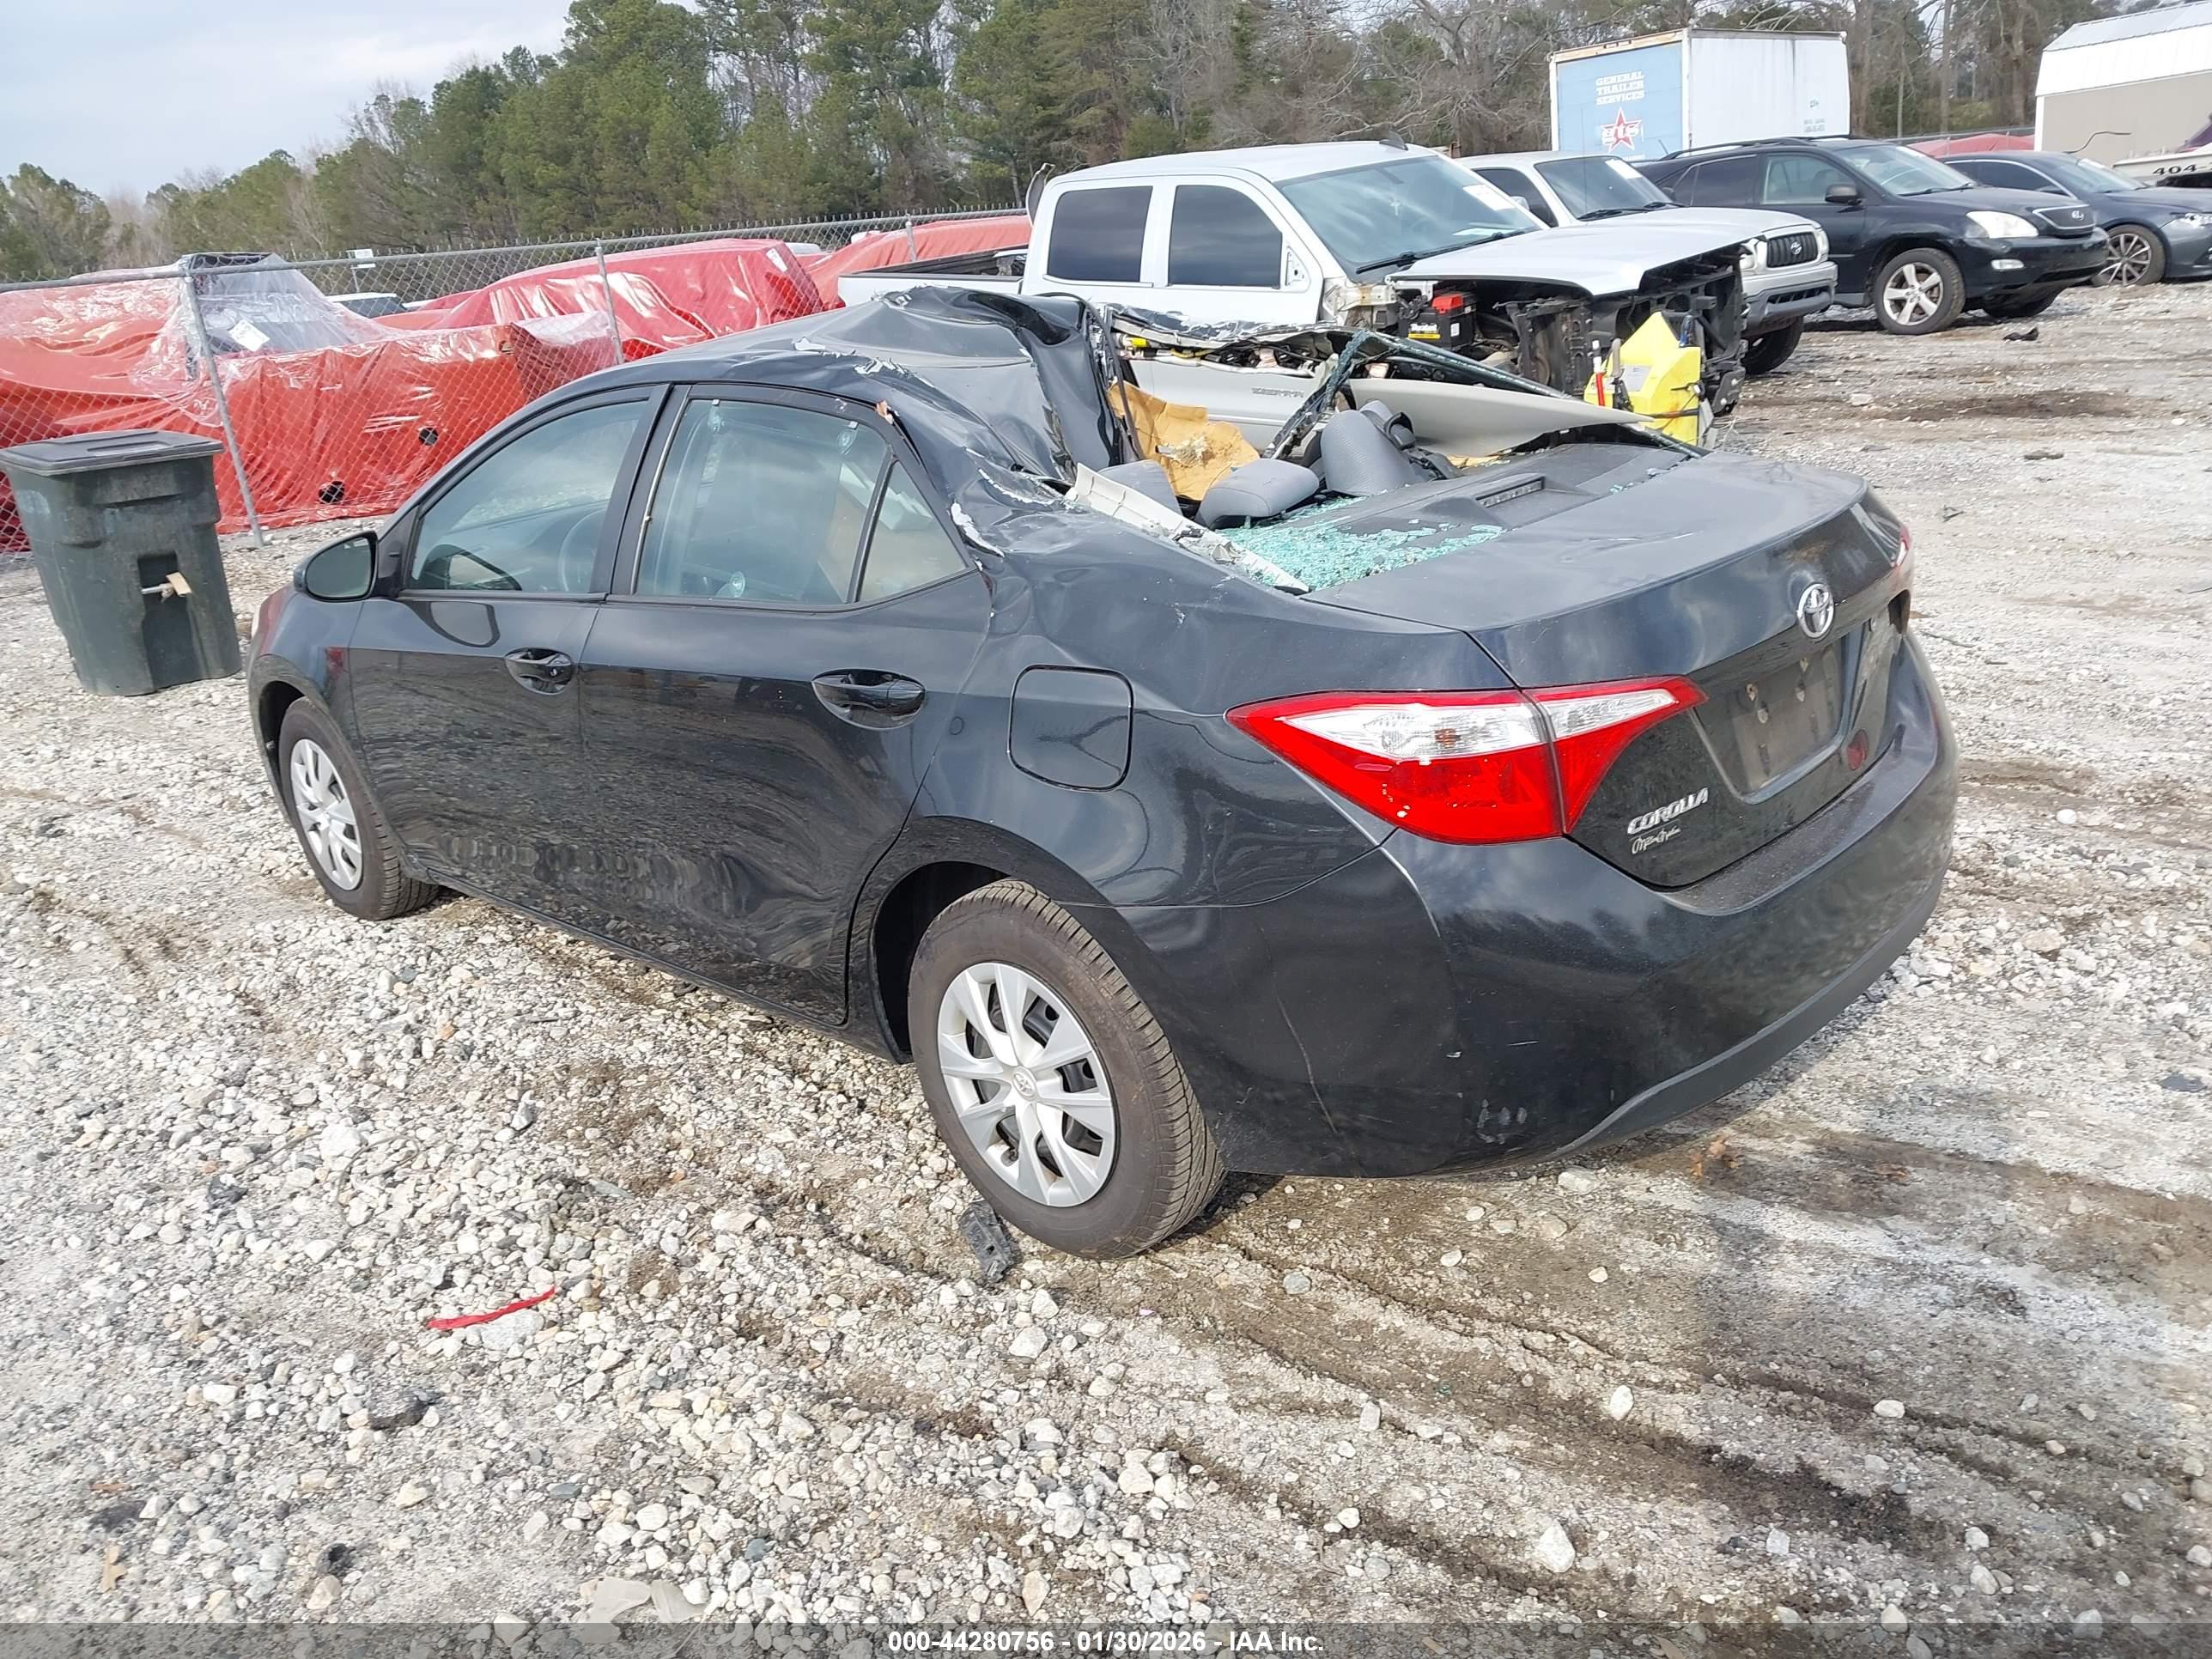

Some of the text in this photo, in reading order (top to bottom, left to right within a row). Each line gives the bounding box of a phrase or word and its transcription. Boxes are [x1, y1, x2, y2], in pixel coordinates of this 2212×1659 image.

[1595, 71, 1645, 87] GENERAL
[1596, 80, 1644, 95] TRAILER
[1595, 89, 1645, 106] SERVICES
[1626, 787, 1709, 835] COROLLA
